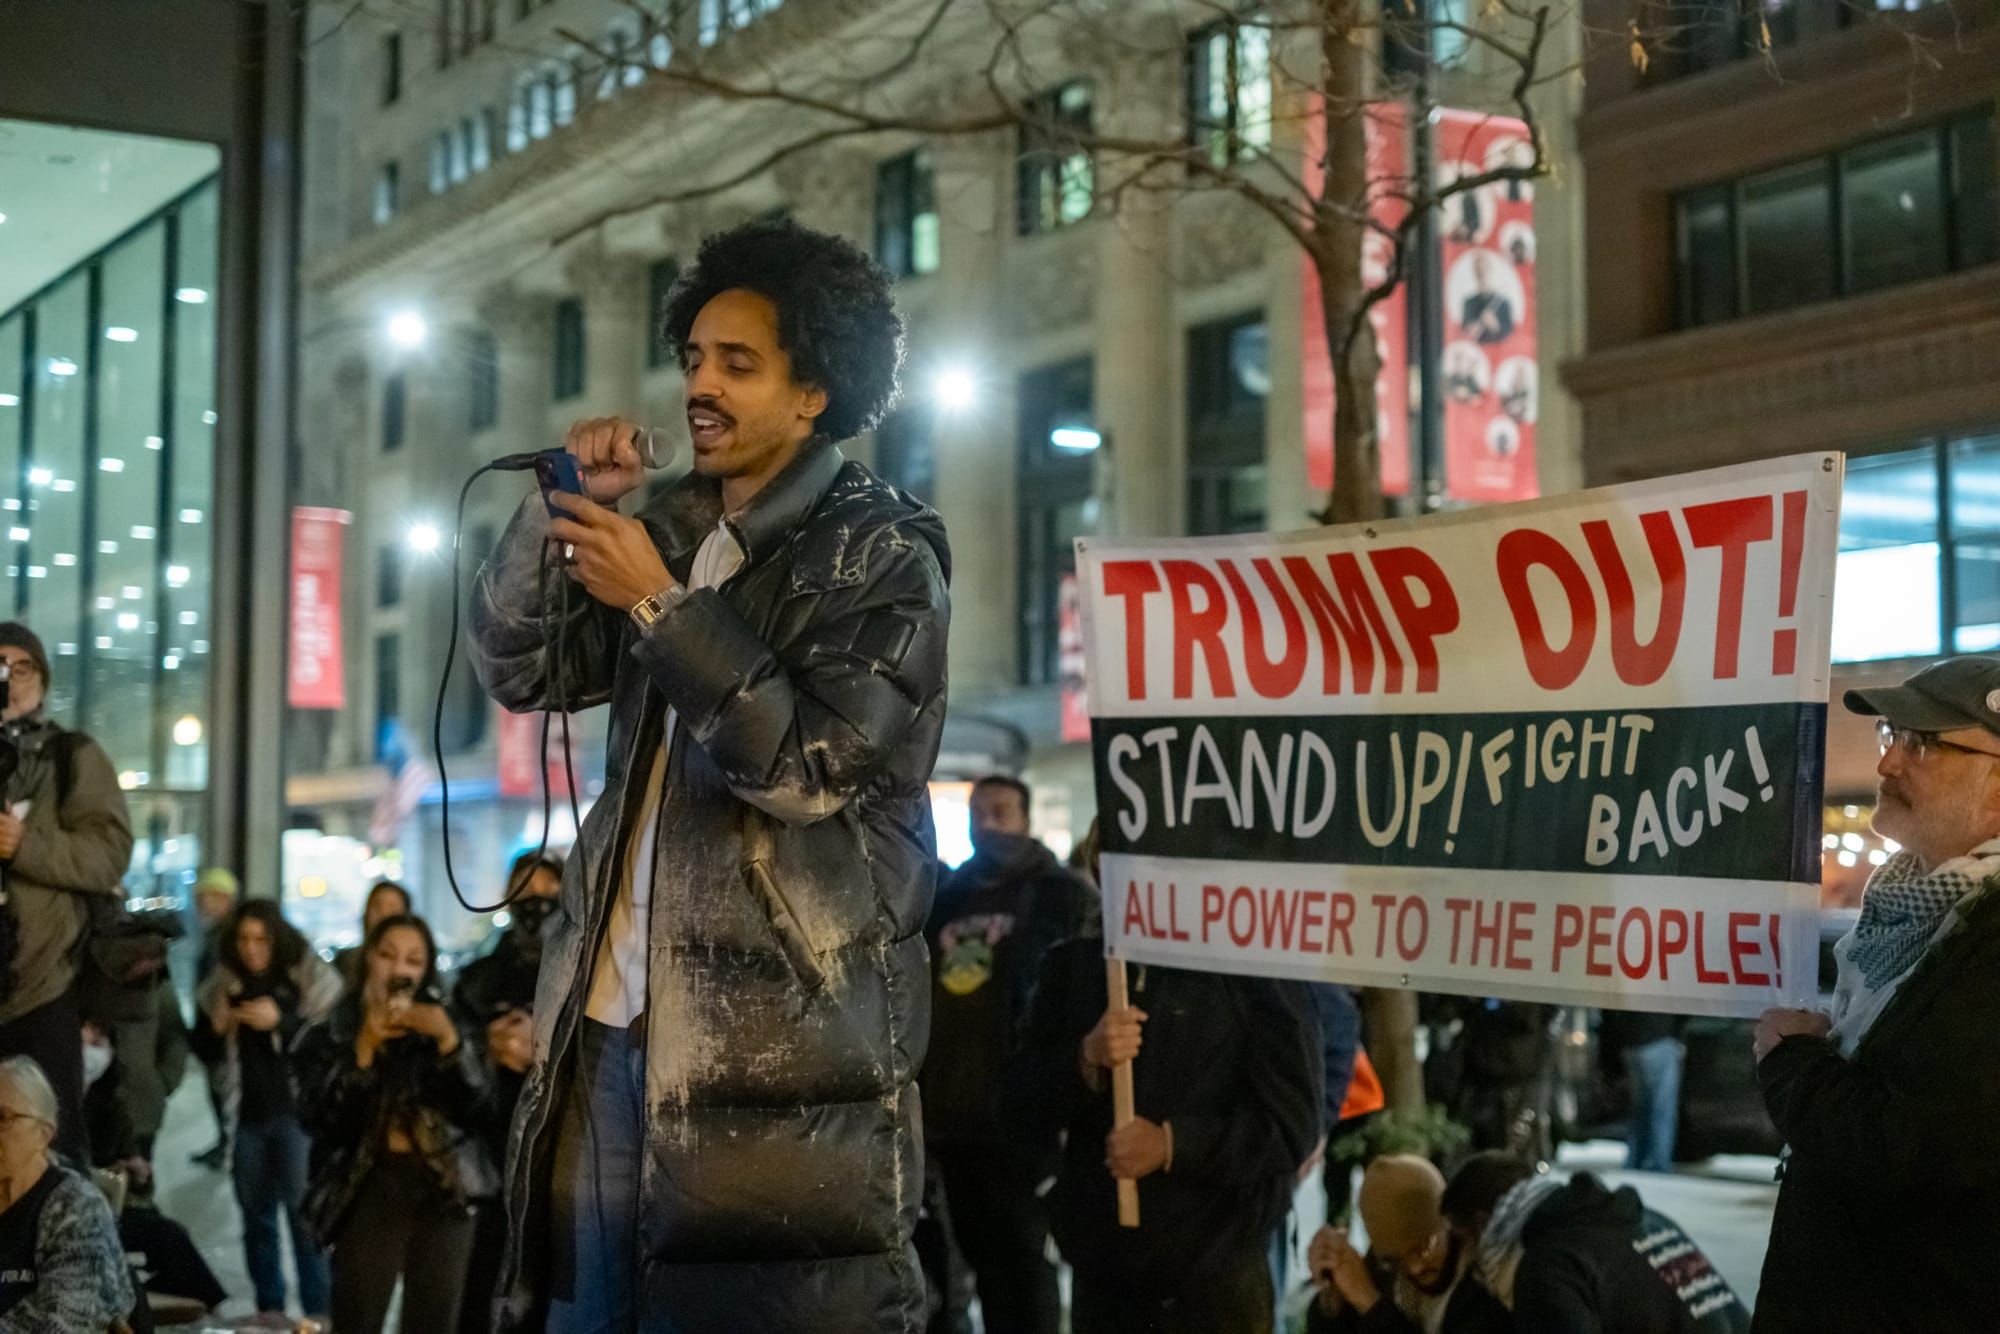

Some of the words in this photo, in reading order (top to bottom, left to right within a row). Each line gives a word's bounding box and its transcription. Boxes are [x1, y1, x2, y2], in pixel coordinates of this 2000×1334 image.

[1102, 546, 1460, 701] TRUMP
[1496, 490, 1808, 691] OUT!
[1108, 724, 1336, 842] STAND
[1356, 731, 1473, 854] UP!
[1481, 714, 1654, 806] FIGHT
[1585, 726, 1774, 866] BACK!
[1124, 881, 1190, 941] ALL
[1202, 885, 1356, 956] POWER
[1372, 895, 1429, 962] TO
[1444, 898, 1536, 971] THE
[1551, 904, 1782, 988] PEOPLE!
